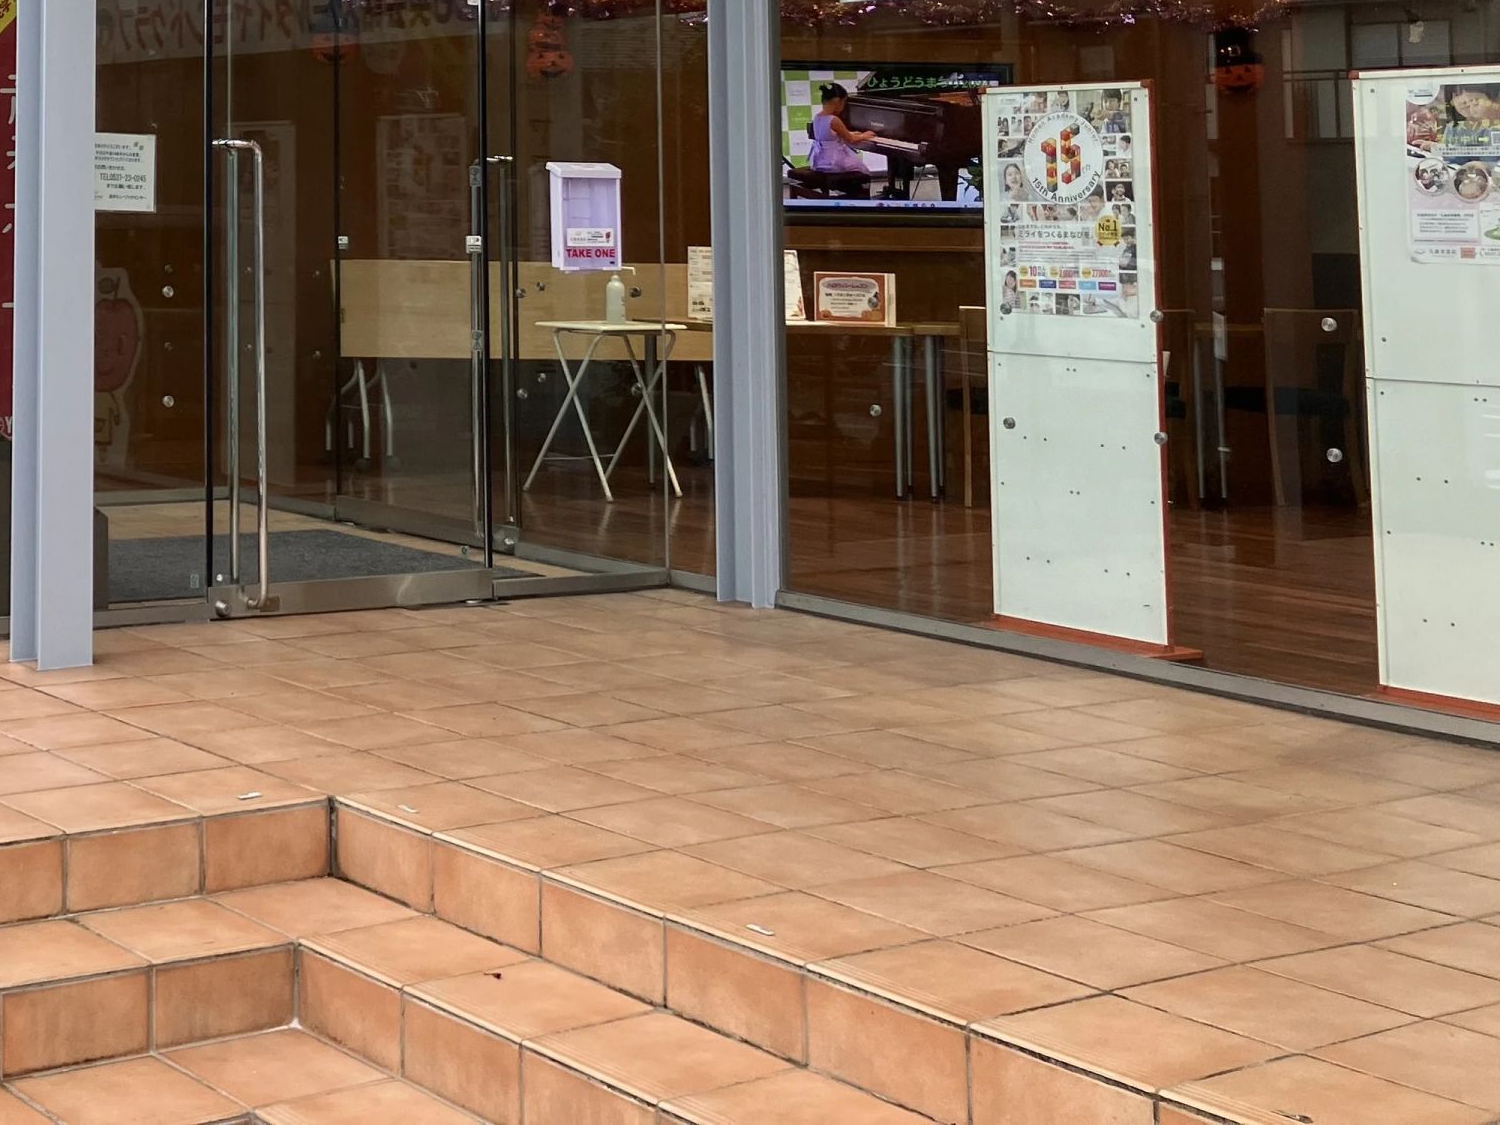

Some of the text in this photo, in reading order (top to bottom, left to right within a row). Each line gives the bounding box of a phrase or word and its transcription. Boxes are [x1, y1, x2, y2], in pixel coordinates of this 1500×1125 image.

[1032, 170, 1100, 203] 15th Anniversary
[566, 248, 615, 258] TAKE ONE
